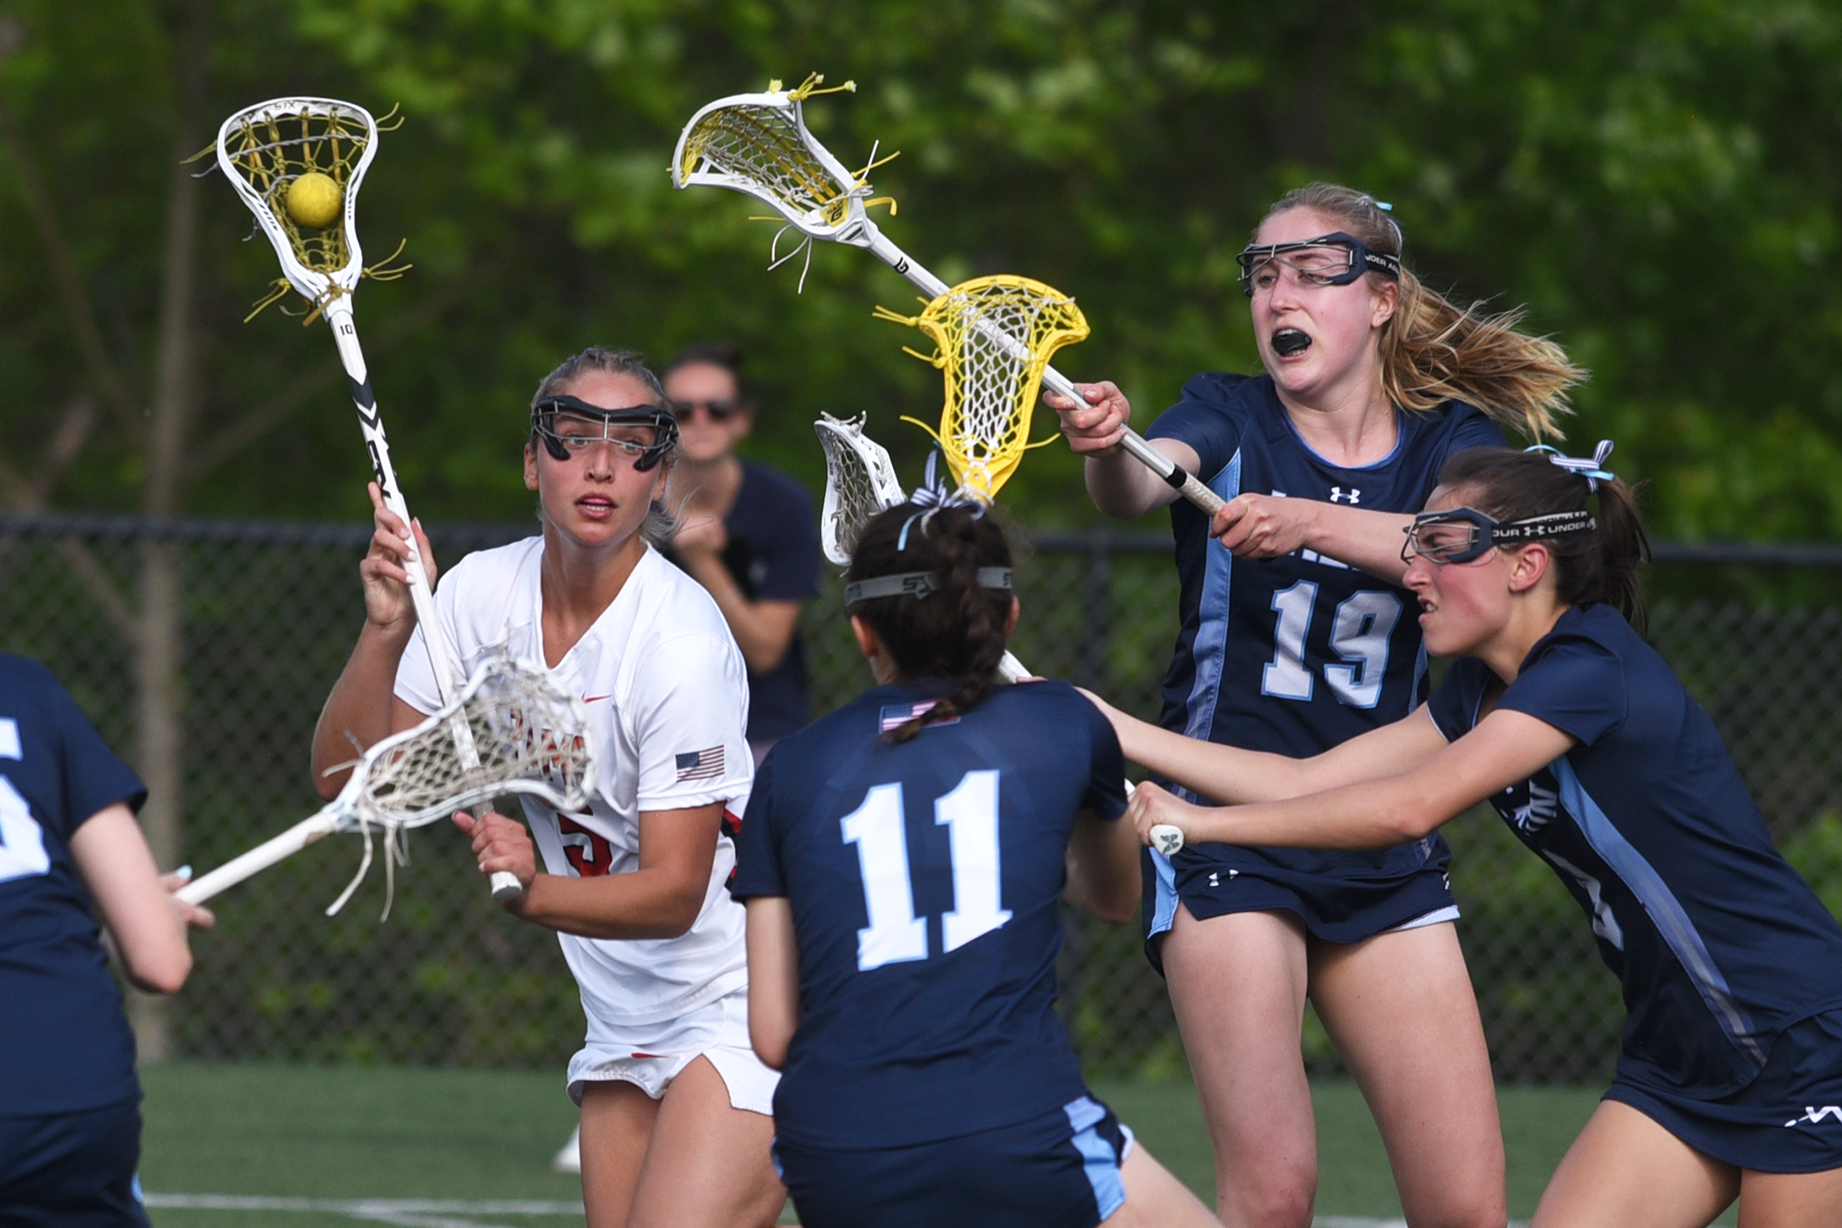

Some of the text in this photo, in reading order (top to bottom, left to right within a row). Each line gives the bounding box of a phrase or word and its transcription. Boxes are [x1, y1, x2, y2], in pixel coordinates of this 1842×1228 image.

[1492, 529, 1519, 538] OUR
[1548, 521, 1586, 534] UNDER
[1261, 578, 1403, 709] 19
[840, 769, 1013, 972] 11
